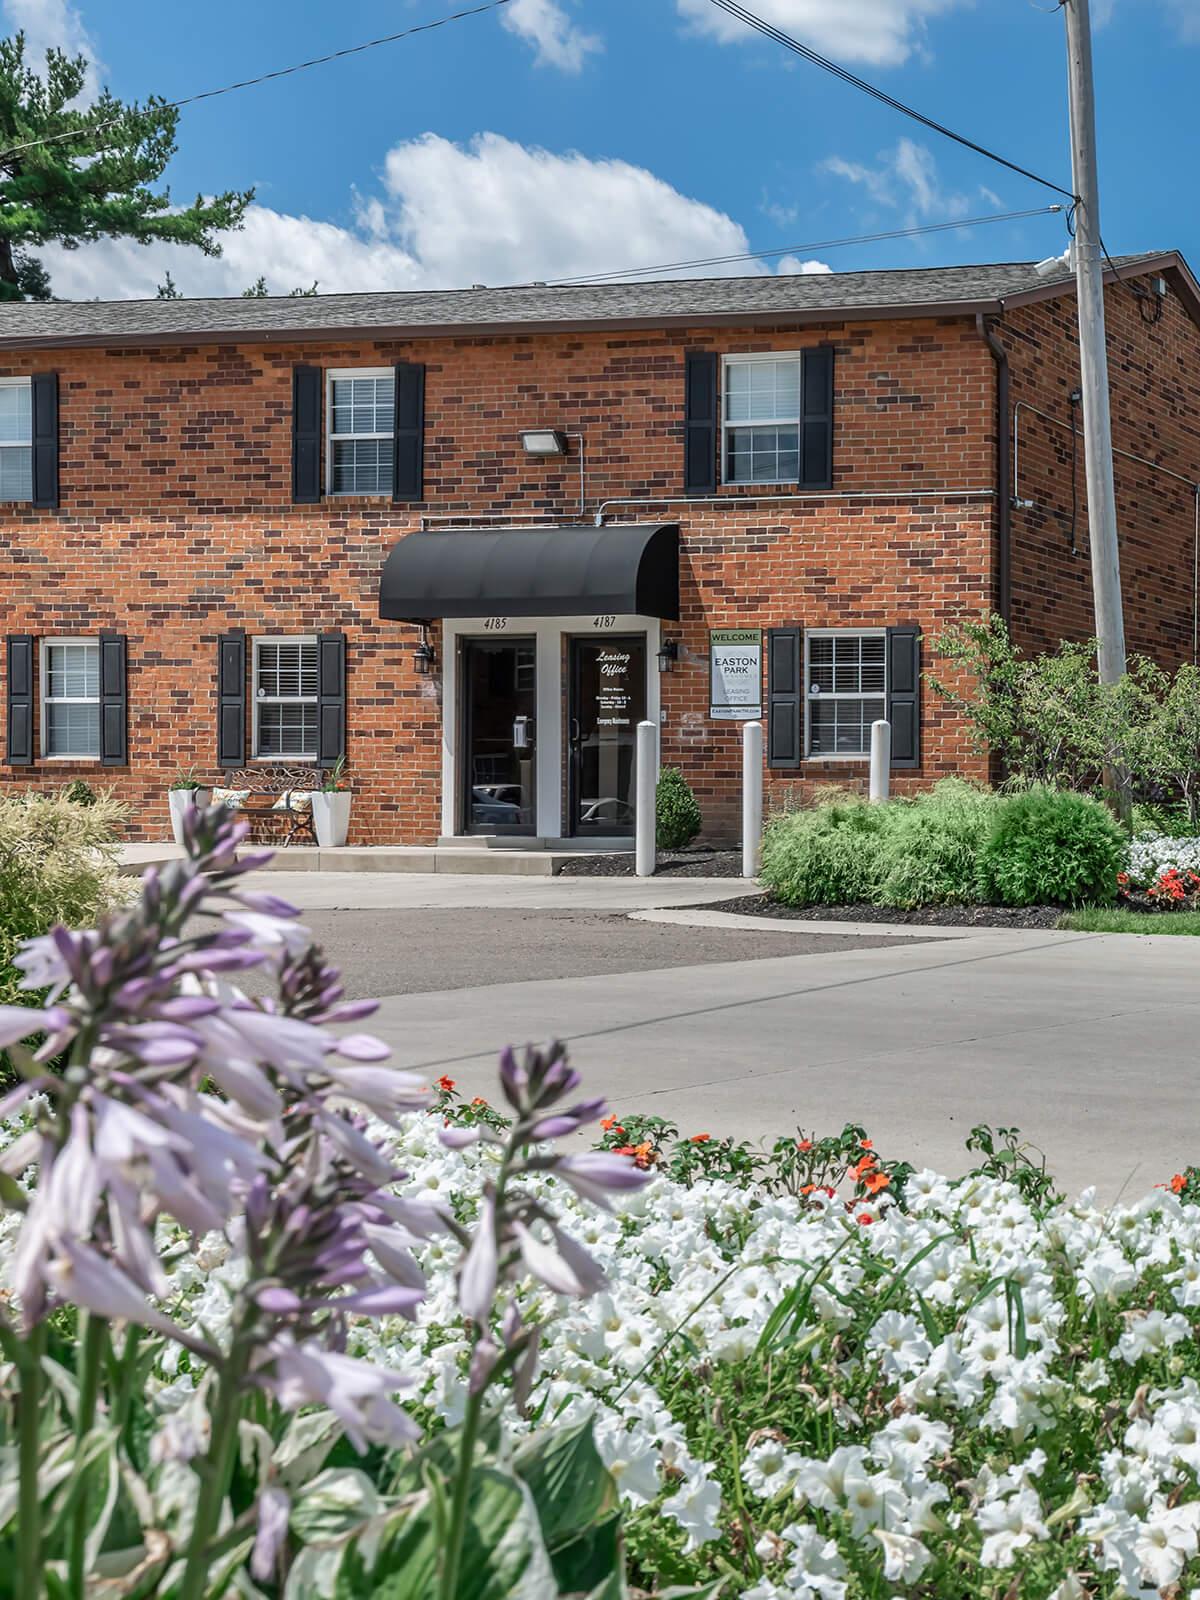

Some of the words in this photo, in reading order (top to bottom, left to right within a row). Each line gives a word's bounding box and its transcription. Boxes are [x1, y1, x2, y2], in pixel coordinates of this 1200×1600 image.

[484, 617, 507, 629] 4185
[593, 615, 616, 627] 4187
[712, 633, 759, 641] WELCOME
[596, 651, 630, 663] Leasing
[715, 658, 757, 666] EASTON
[601, 664, 627, 676] Office
